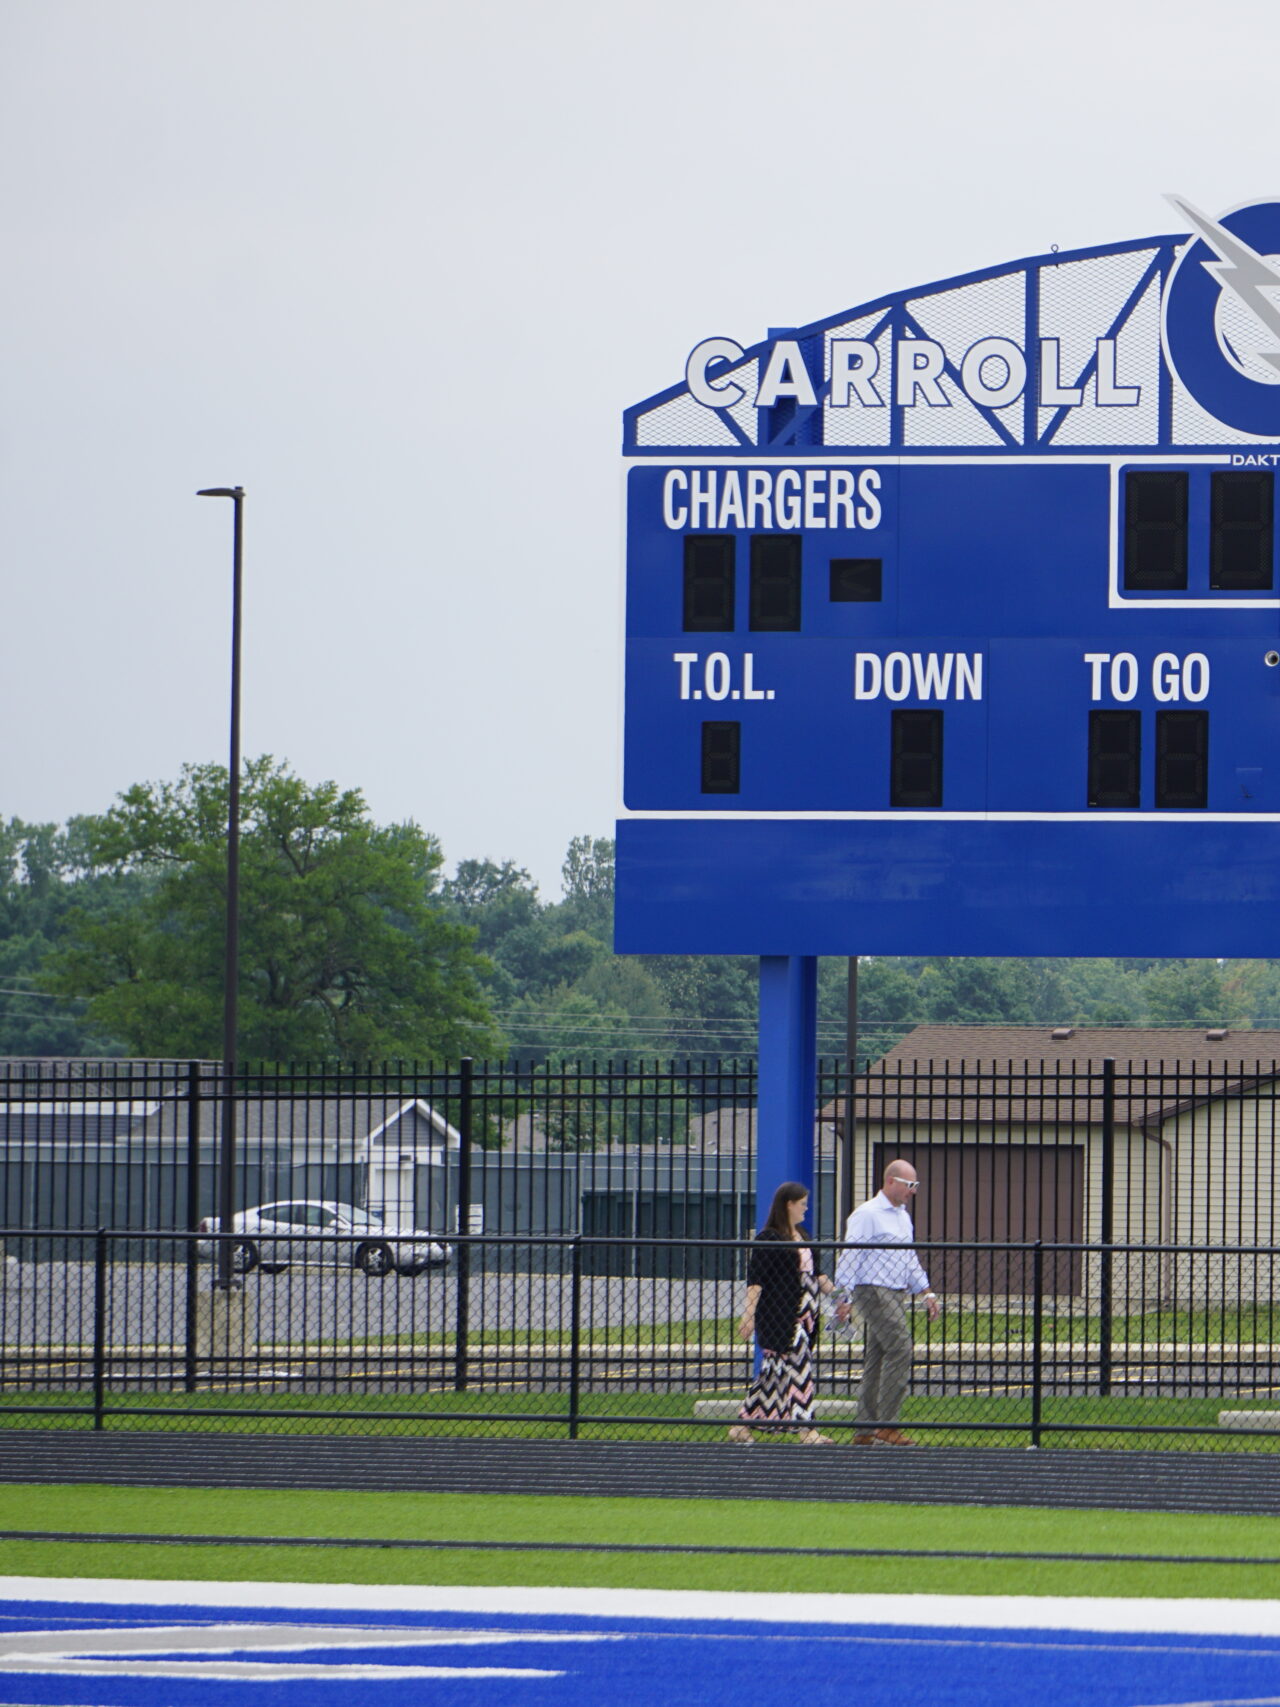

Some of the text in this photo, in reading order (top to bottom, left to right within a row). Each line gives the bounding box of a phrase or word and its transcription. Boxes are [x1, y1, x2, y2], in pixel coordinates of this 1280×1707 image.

[685, 337, 1142, 408] CARROLL
[662, 469, 883, 532] CHARGERS
[673, 652, 777, 702] T.O.L.
[853, 651, 984, 703] DOWN
[1084, 651, 1211, 704] TO GO
